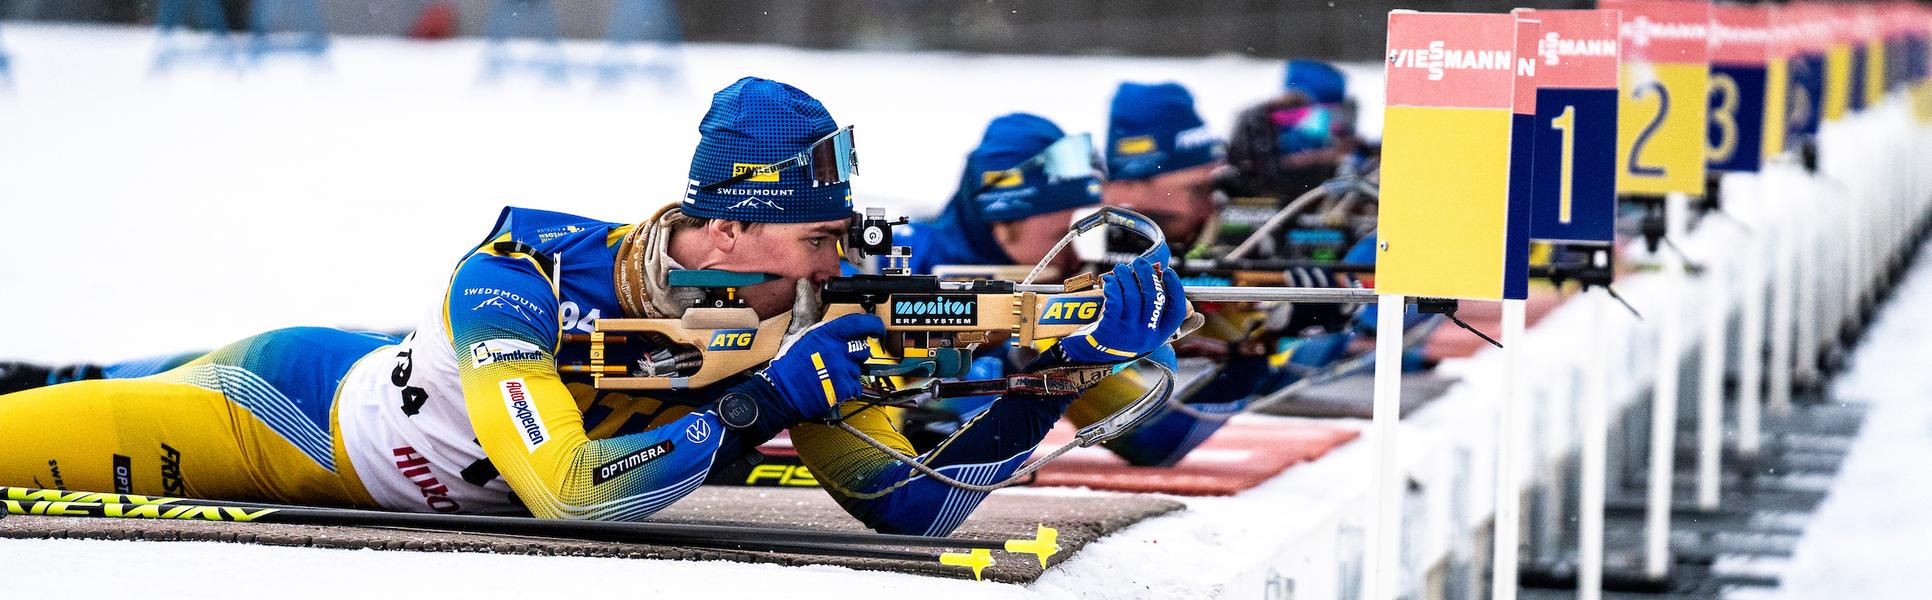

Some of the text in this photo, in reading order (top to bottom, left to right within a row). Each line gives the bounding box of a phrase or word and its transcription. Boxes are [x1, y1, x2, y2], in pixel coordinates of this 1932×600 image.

[1390, 40, 1511, 80] VIESSMANN
[1627, 81, 1671, 175] 2
[1706, 72, 1741, 163] 3
[1551, 105, 1576, 224] 1
[717, 187, 795, 196] SWEDEMOUNT
[464, 287, 545, 316] SWEDEMOUNT
[895, 296, 976, 316] monitor
[1042, 301, 1099, 320] ATG
[492, 348, 543, 363] Jämtkraft
[710, 332, 752, 347] ATG
[506, 380, 545, 446] Autoexperten
[160, 442, 185, 497] FRIS
[601, 444, 666, 479] OPTIMERA
